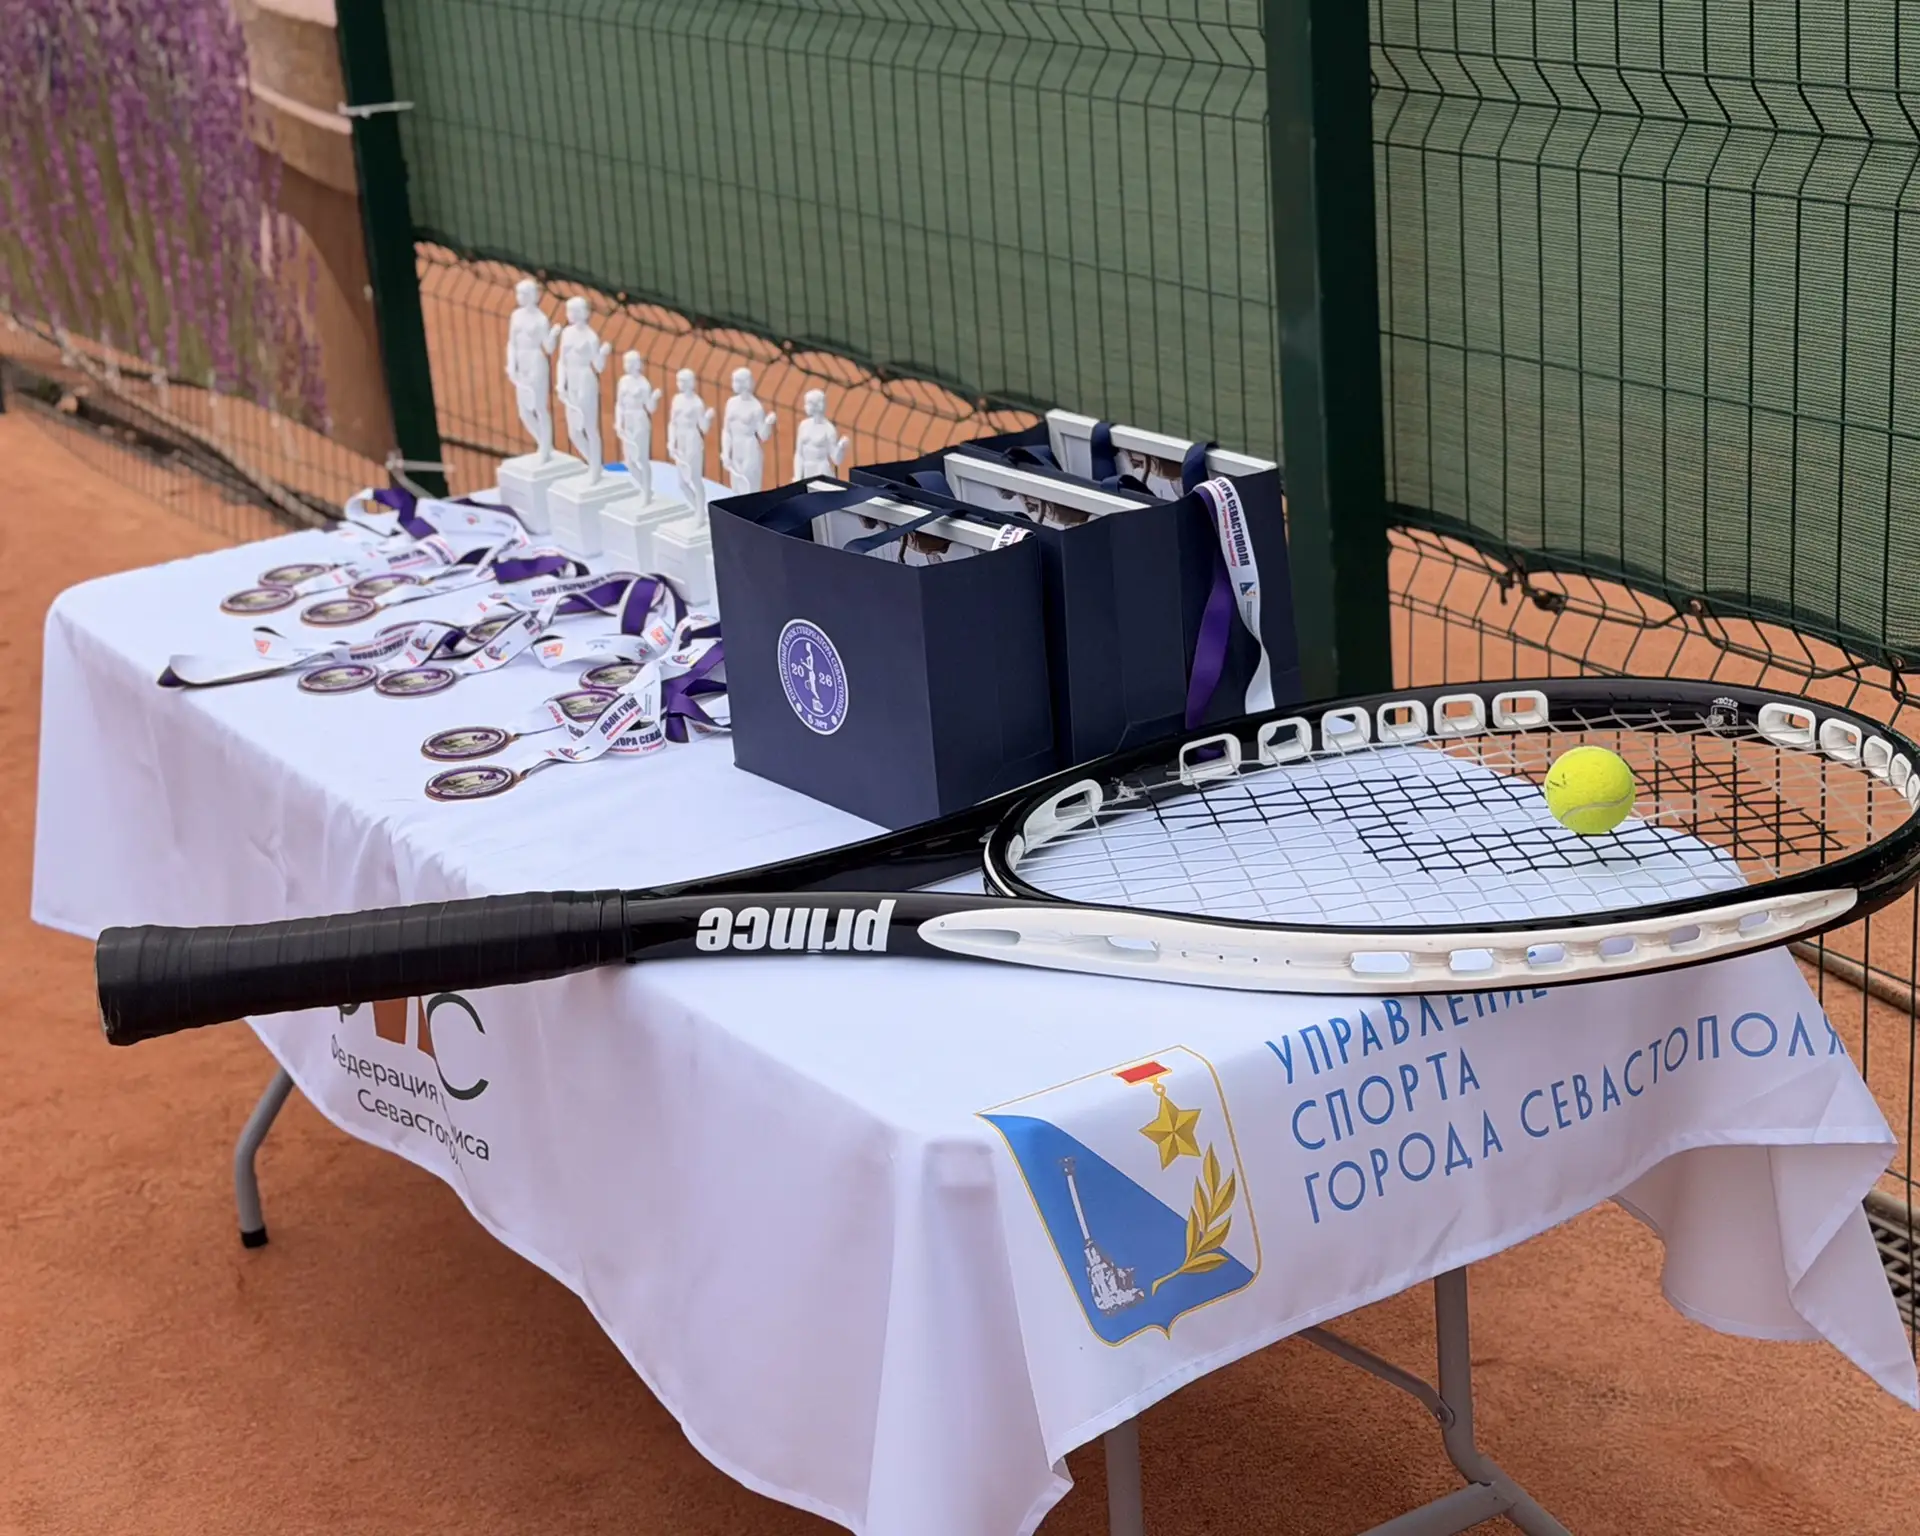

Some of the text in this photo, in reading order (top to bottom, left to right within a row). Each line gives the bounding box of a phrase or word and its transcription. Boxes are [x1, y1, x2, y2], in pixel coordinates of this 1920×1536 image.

[1227, 499, 1251, 567] СЕВАСТОПОЛЯ
[791, 662, 833, 688] 20 26
[695, 899, 897, 953] prince
[1265, 988, 1548, 1084] УПРАВЛЕН
[1291, 1047, 1481, 1150] СПОРТА
[1303, 1010, 1845, 1224] ГОРОДА СЕВАСТОПОЛЯ
